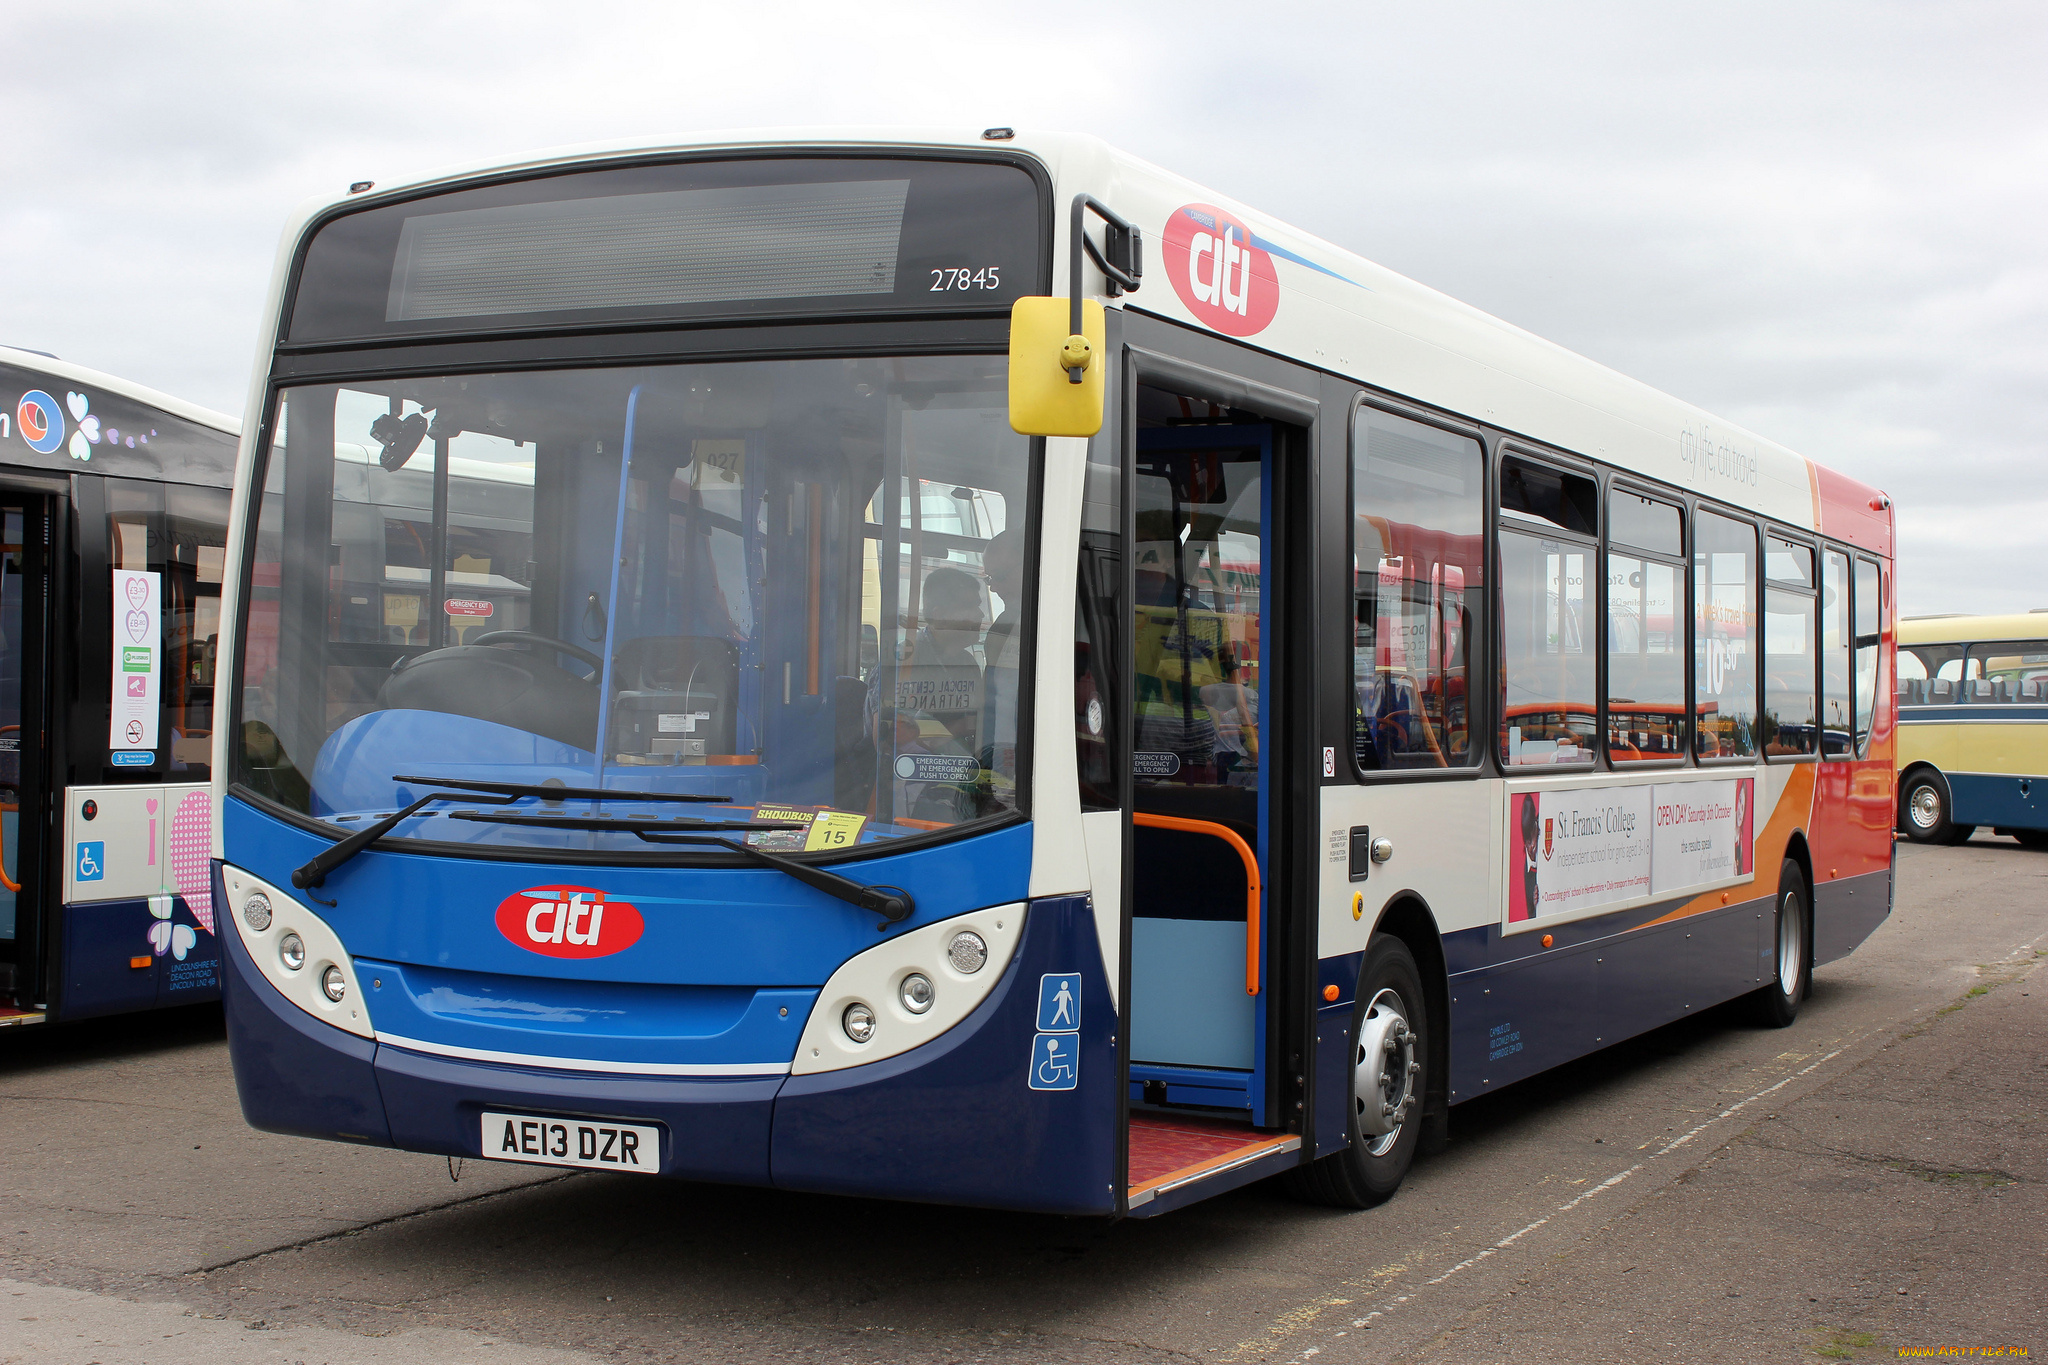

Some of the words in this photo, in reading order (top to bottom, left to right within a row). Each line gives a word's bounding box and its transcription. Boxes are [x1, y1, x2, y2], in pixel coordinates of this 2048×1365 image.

[1191, 211, 1213, 228] CAMBRIDGE
[929, 267, 1000, 292] 27845
[1189, 225, 1251, 317] citi
[1681, 420, 1698, 480] city
[1733, 445, 1757, 487] travel
[450, 600, 478, 608] EMERGENCY
[478, 601, 489, 609] EXIT
[928, 765, 969, 773] EMERGENCY
[757, 809, 815, 821] SHOWBUS
[1558, 811, 1569, 839] St.
[1606, 806, 1636, 838] College
[1657, 805, 1675, 827] OPEN
[1675, 804, 1688, 824] DAY
[1688, 804, 1707, 826] Saturday
[1715, 802, 1732, 819] October
[823, 830, 847, 844] 15
[1701, 835, 1712, 854] speak
[1590, 843, 1607, 862] school
[1607, 842, 1615, 860] for
[1626, 839, 1638, 862] aged
[526, 893, 604, 946] citi
[171, 961, 209, 973] LINCOLNSHIRE
[171, 972, 195, 981] DEACON
[196, 970, 212, 978] ROAD
[170, 981, 195, 990] LINCOLN
[502, 1120, 568, 1158] AE13
[577, 1126, 640, 1165] DZR
